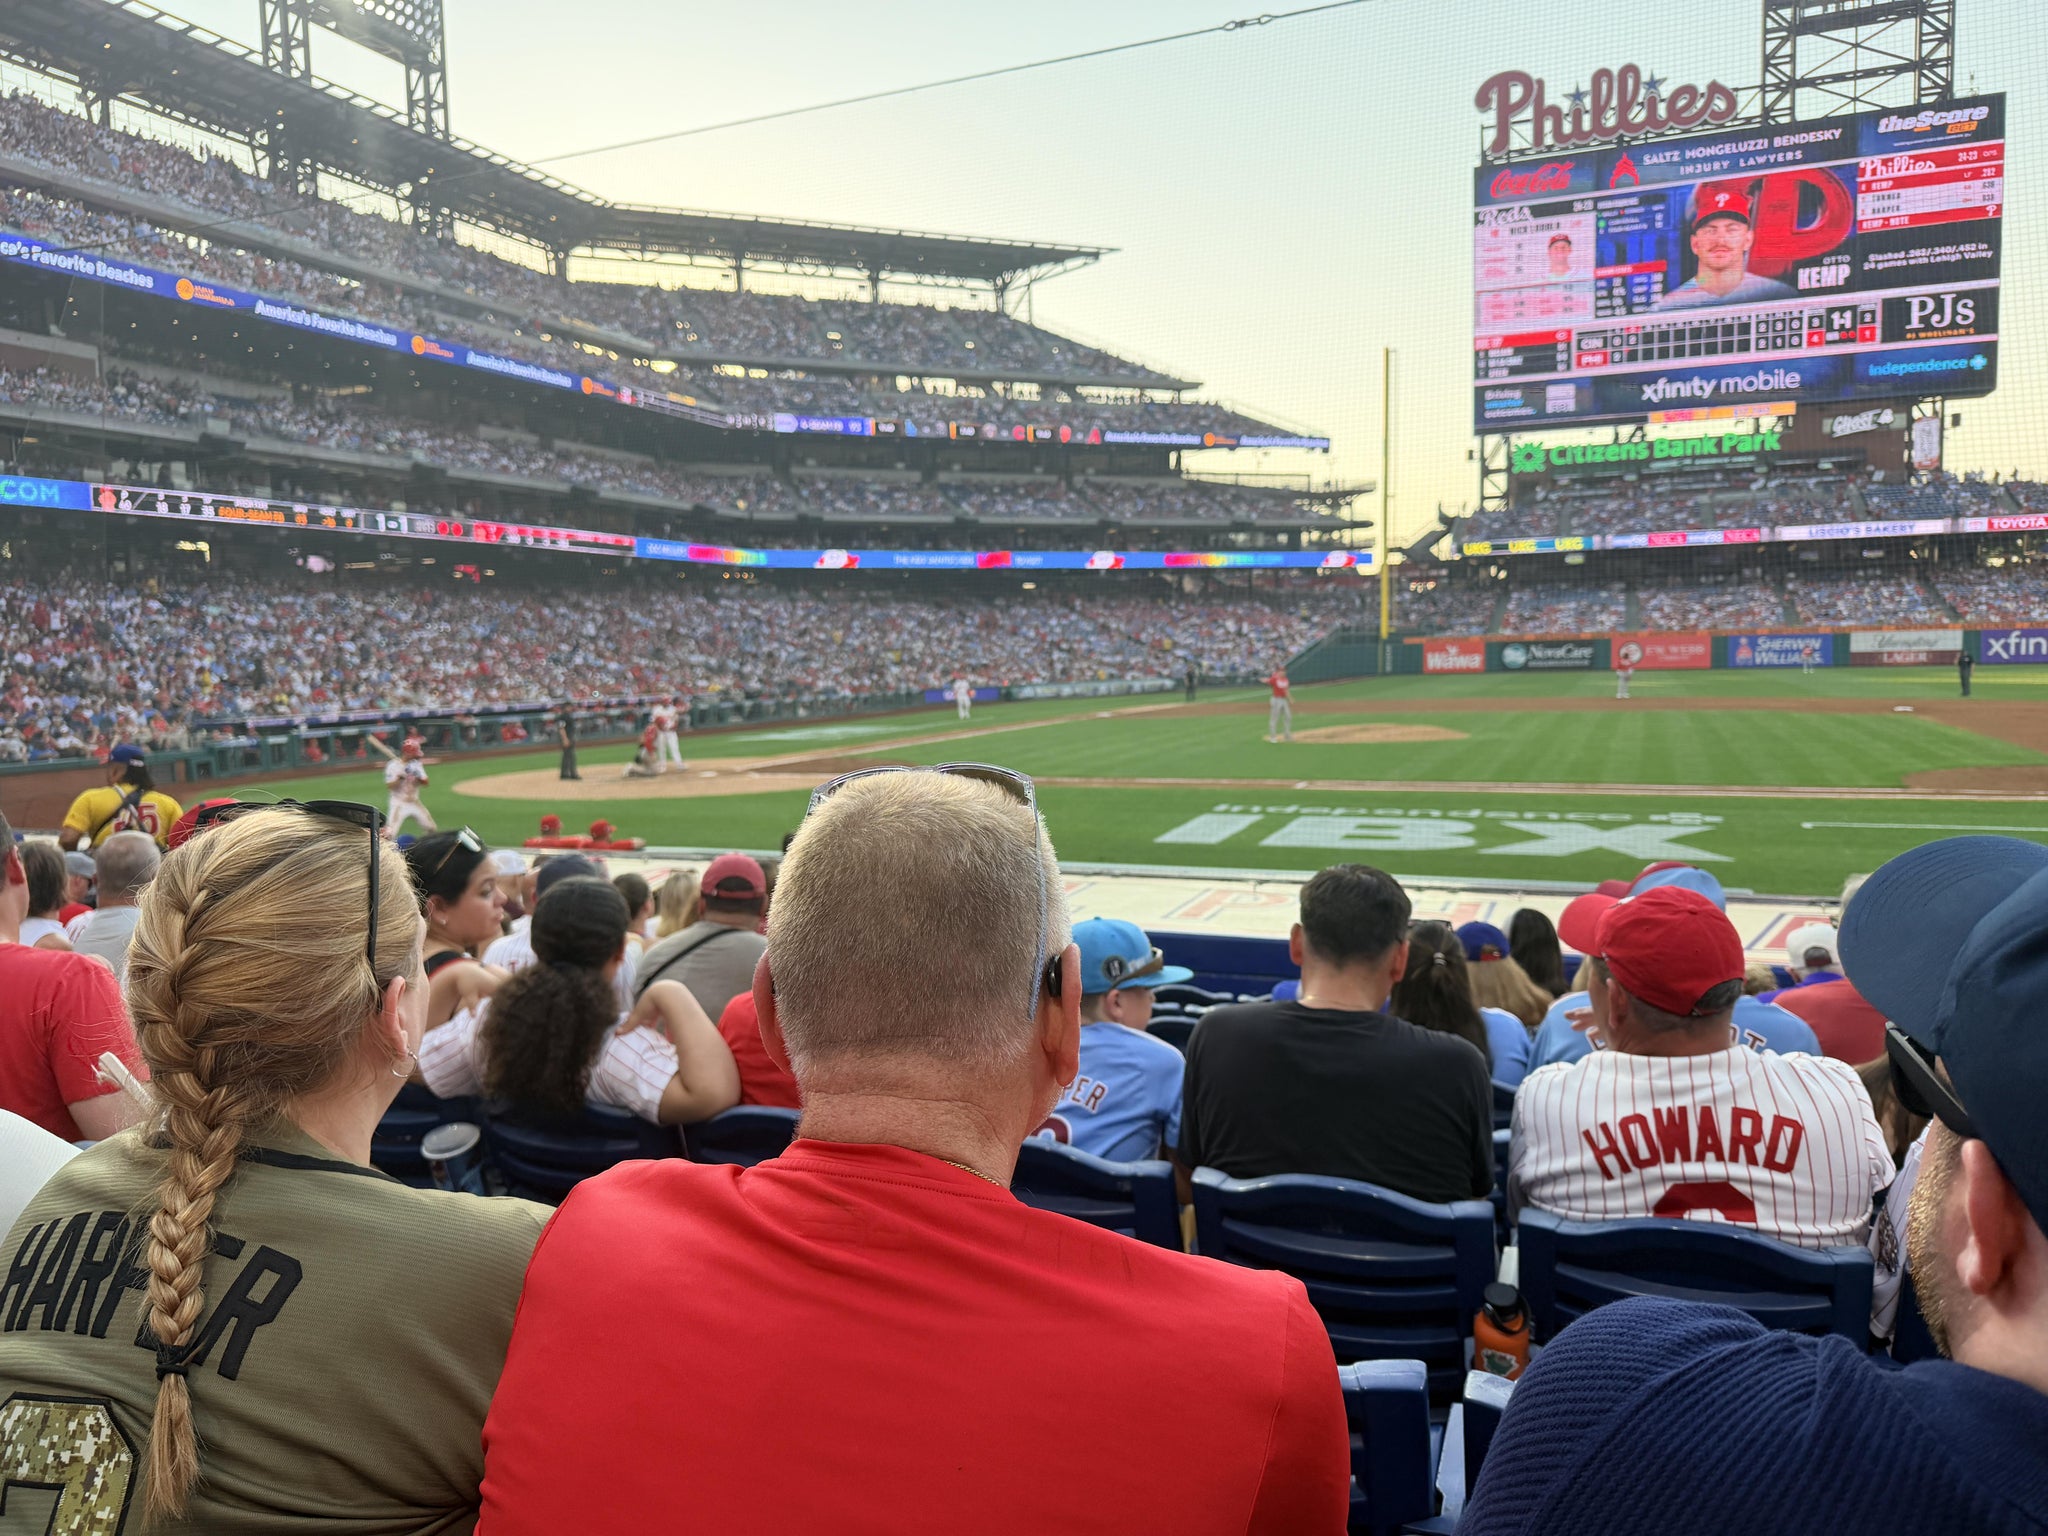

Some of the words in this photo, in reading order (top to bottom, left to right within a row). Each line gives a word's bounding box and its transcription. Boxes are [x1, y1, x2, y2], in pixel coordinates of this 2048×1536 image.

[1475, 63, 1738, 154] Phillies
[1877, 105, 1989, 134] theScore
[1643, 149, 1681, 166] SALTZ
[1685, 138, 1769, 160] MONGELUZZI
[1774, 128, 1843, 148] BENDESKY
[1680, 160, 1730, 175] INJURY
[1739, 151, 1803, 168] LAWYERS
[1859, 156, 1936, 179] Phillies
[31, 245, 95, 275] Favorite
[95, 260, 154, 289] Beaches
[1963, 250, 1994, 260] Valley
[1797, 264, 1851, 290] KEMP
[1905, 293, 1976, 330] PJs
[1868, 356, 1968, 377] Independence
[1641, 376, 1717, 403] xfinity
[1720, 368, 1800, 394] mobile
[1550, 441, 1650, 466] Citizens
[1653, 434, 1719, 458] Bank
[1721, 428, 1782, 453] Park
[1865, 524, 1916, 535] BAKERY
[1991, 516, 2047, 530] TOYOTA
[1426, 652, 1481, 671] Wawa
[1528, 644, 1594, 660] NovaCare
[1153, 813, 1736, 862] IBX
[1582, 1105, 1803, 1180] HOWARD
